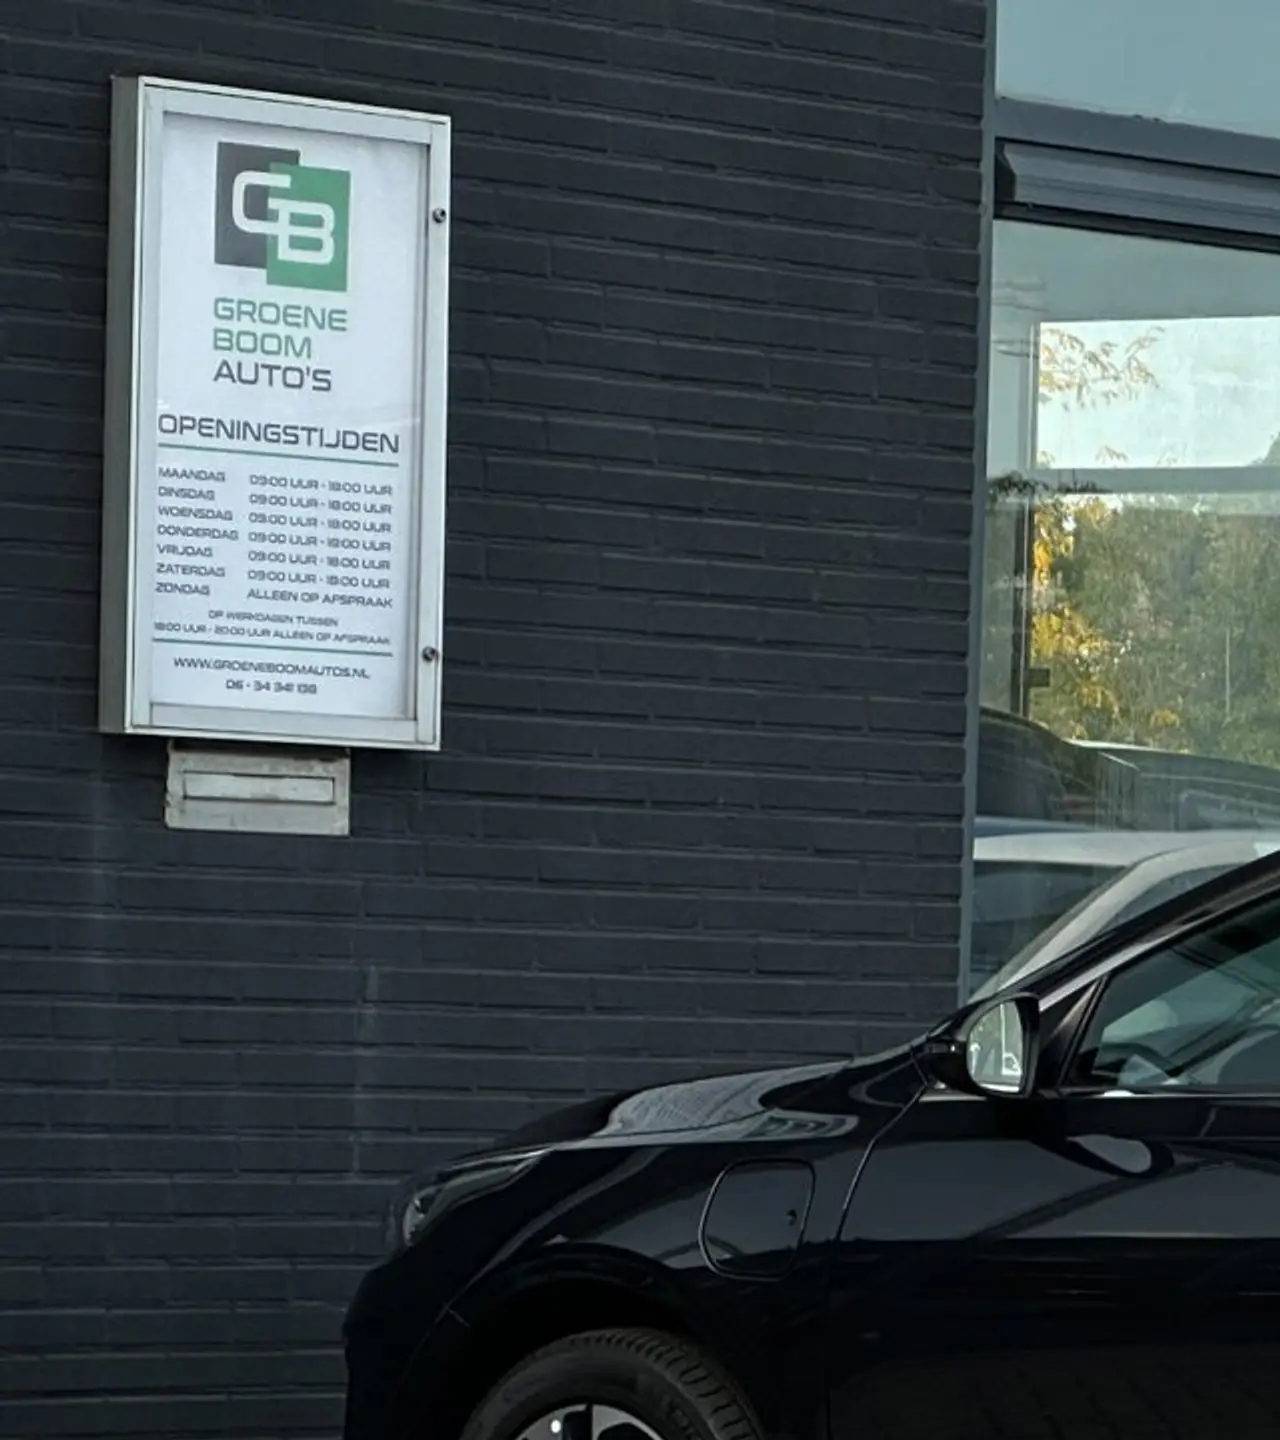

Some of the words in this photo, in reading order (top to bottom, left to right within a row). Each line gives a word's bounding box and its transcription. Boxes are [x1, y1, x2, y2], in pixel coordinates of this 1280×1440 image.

[213, 297, 348, 332] GROENE
[213, 327, 313, 359] BOOM
[213, 359, 333, 392] AUTO'S
[158, 413, 400, 453] OPENINGSTIJDEN
[158, 467, 226, 482] MAANDAG
[157, 524, 239, 541] DONDERDAG
[247, 588, 299, 602] ALLEEN
[322, 593, 393, 609] AFSPRAAK
